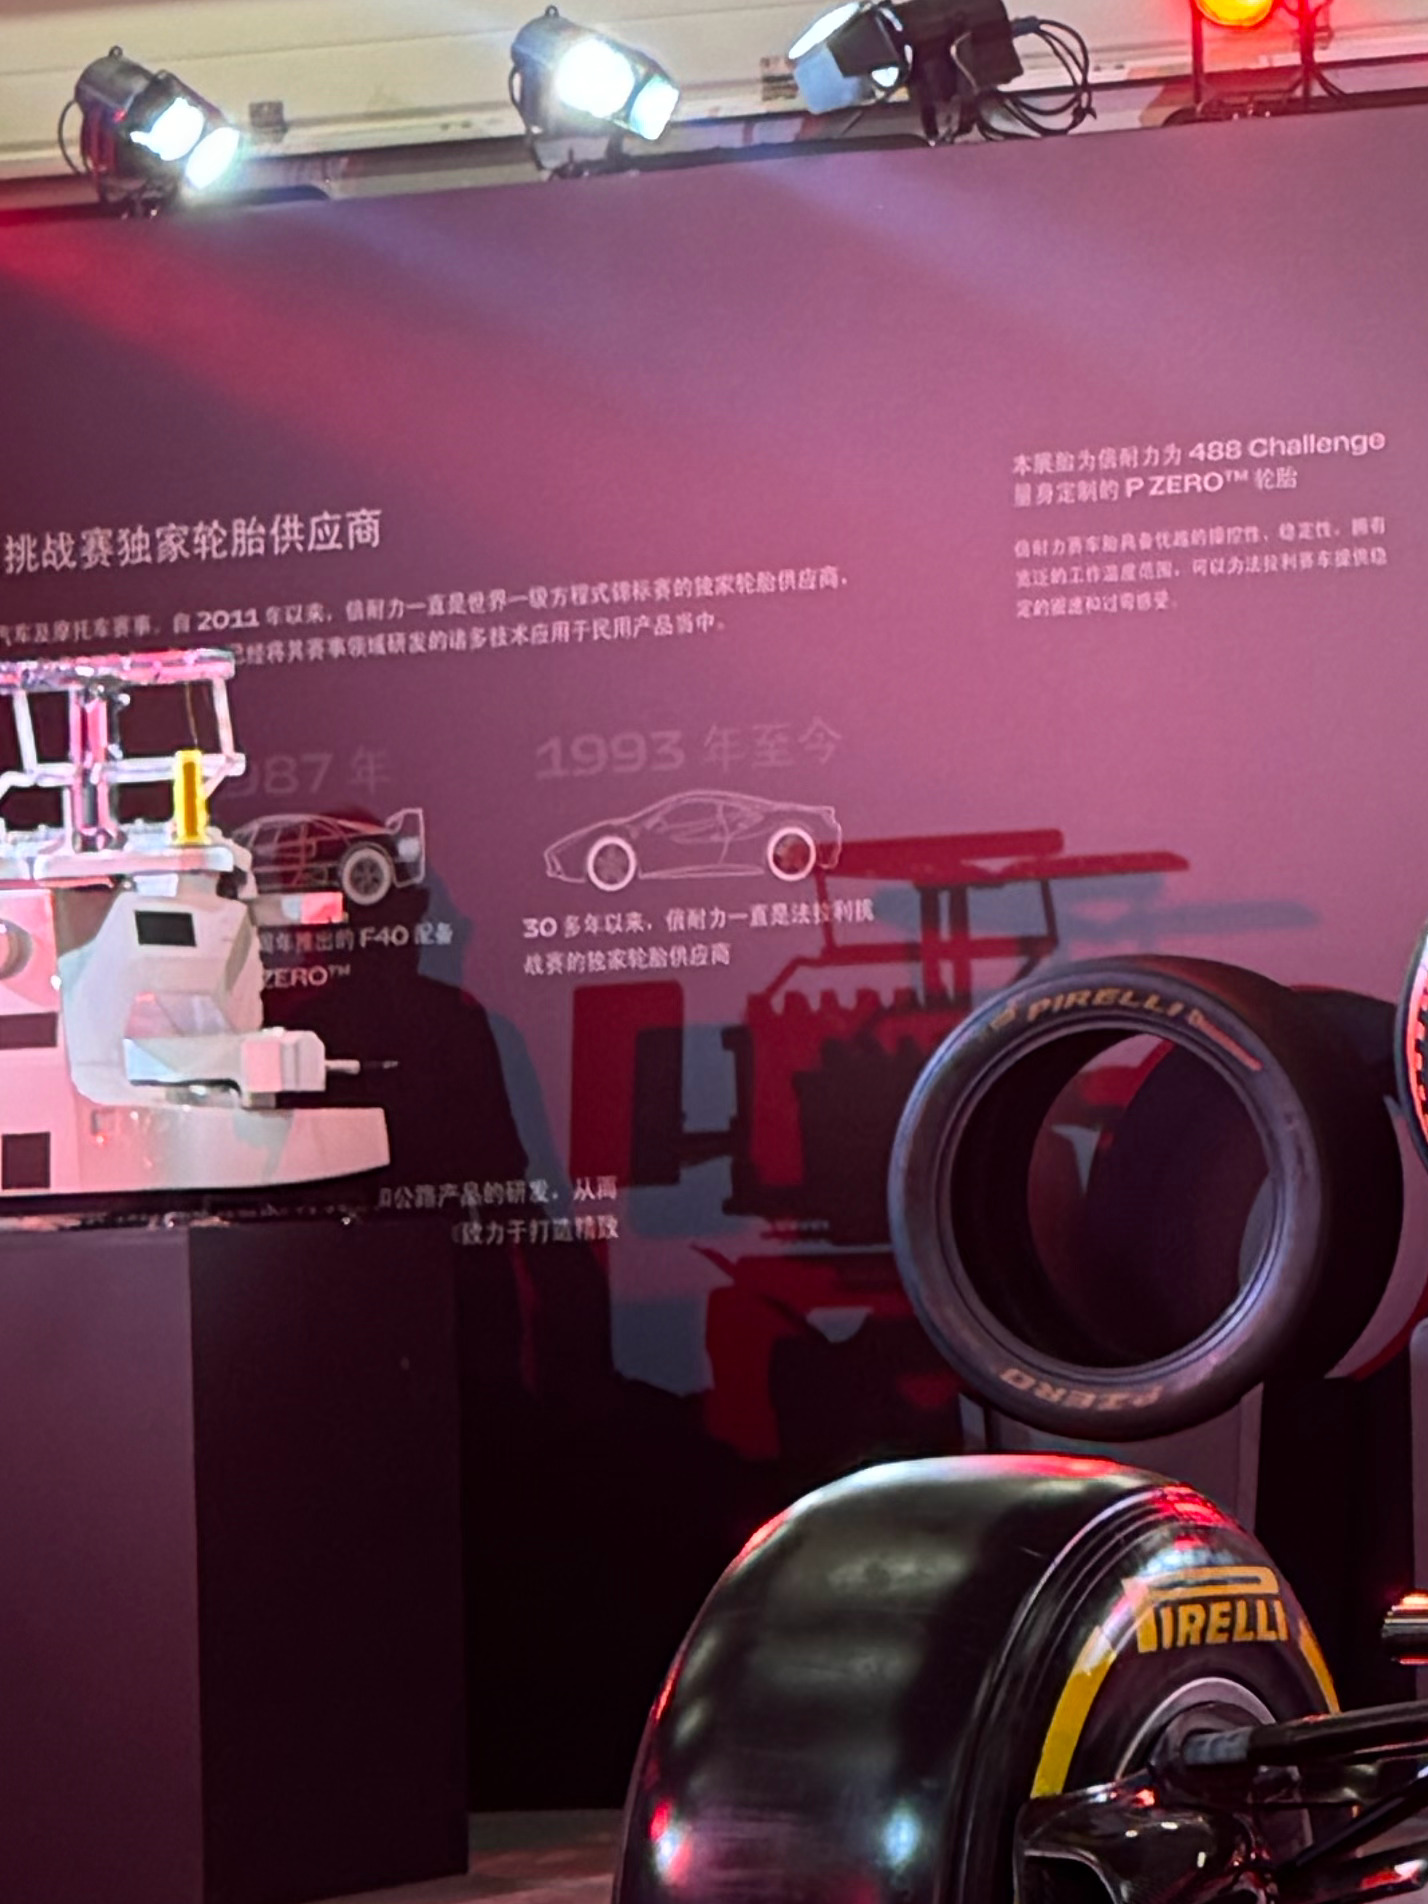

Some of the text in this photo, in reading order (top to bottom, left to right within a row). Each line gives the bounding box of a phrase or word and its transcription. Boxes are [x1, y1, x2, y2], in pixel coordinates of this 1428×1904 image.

[1189, 439, 1242, 462] 488
[1249, 432, 1386, 458] Challenge
[1125, 477, 1144, 498] P
[1254, 466, 1297, 491] 轮胎
[5, 508, 382, 575] 挑战赛独家轮胎供应商
[198, 608, 259, 632] 2011
[536, 716, 842, 780] 1993 年至今
[352, 744, 391, 795] 年
[360, 924, 409, 948] F40
[522, 917, 557, 939] 30
[1028, 986, 1185, 1023] PIRELLI
[1121, 1566, 1288, 1654] PIRELLI
